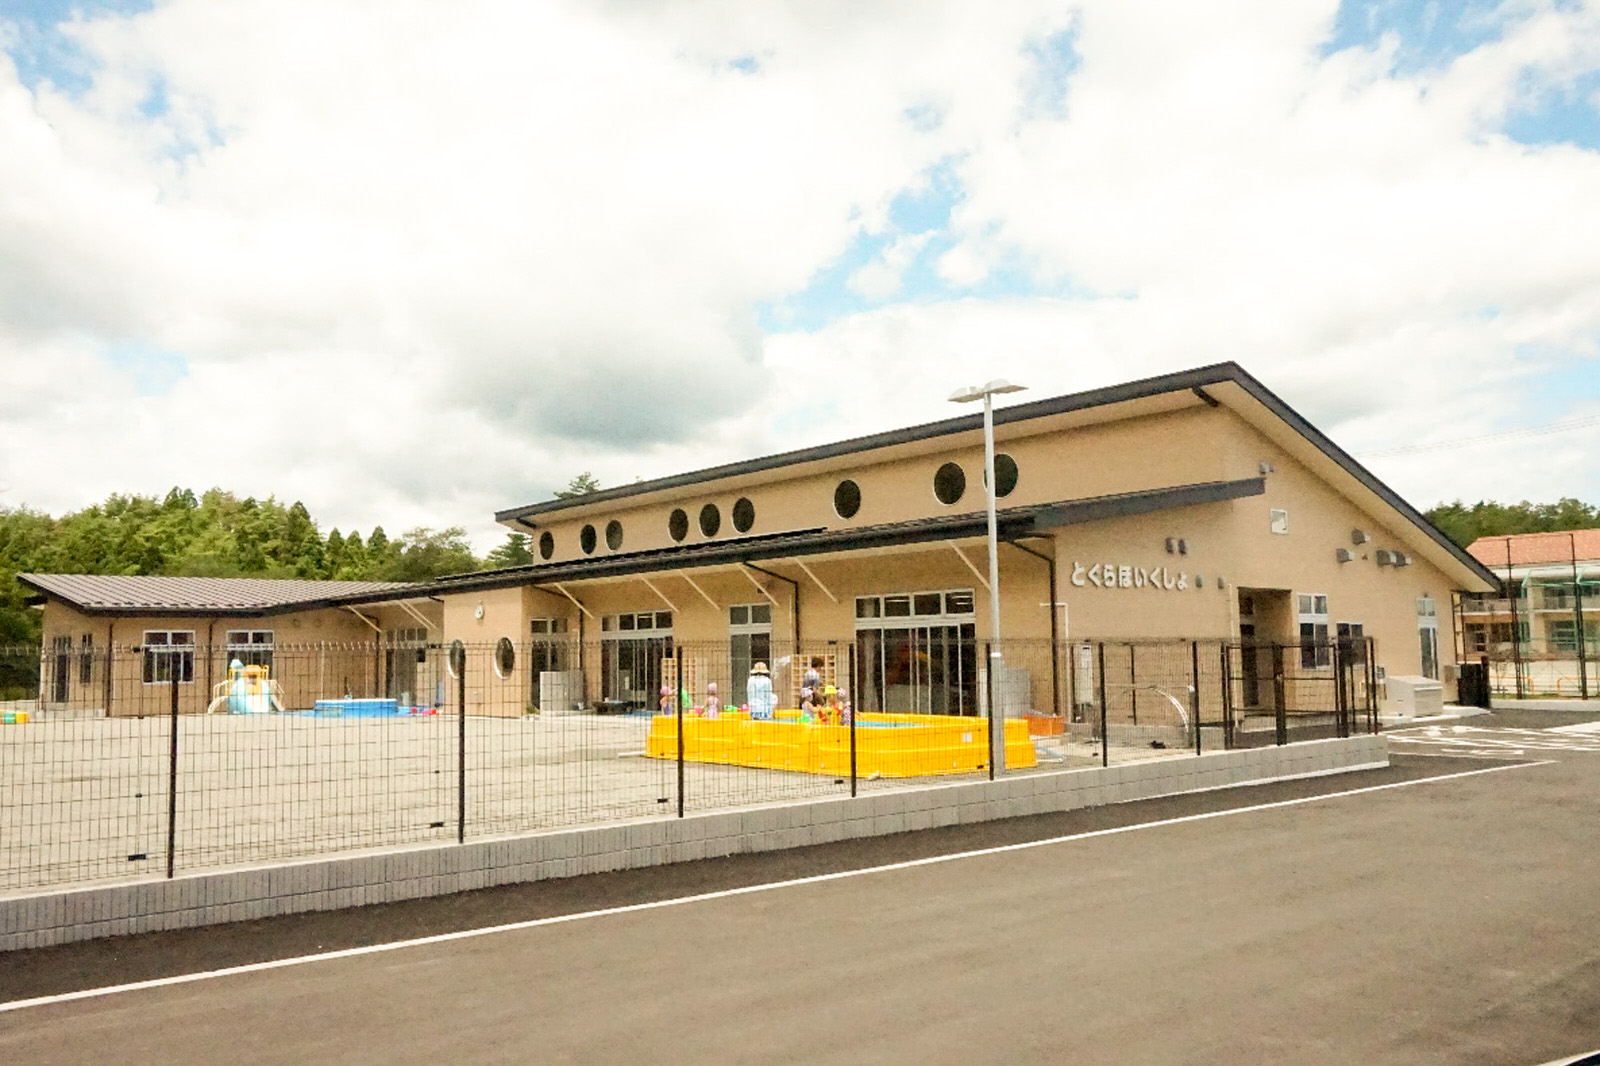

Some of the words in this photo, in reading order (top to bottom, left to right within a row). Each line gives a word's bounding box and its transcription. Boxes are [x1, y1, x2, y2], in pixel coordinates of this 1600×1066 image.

[1071, 561, 1188, 591] とくらほいくしょ
